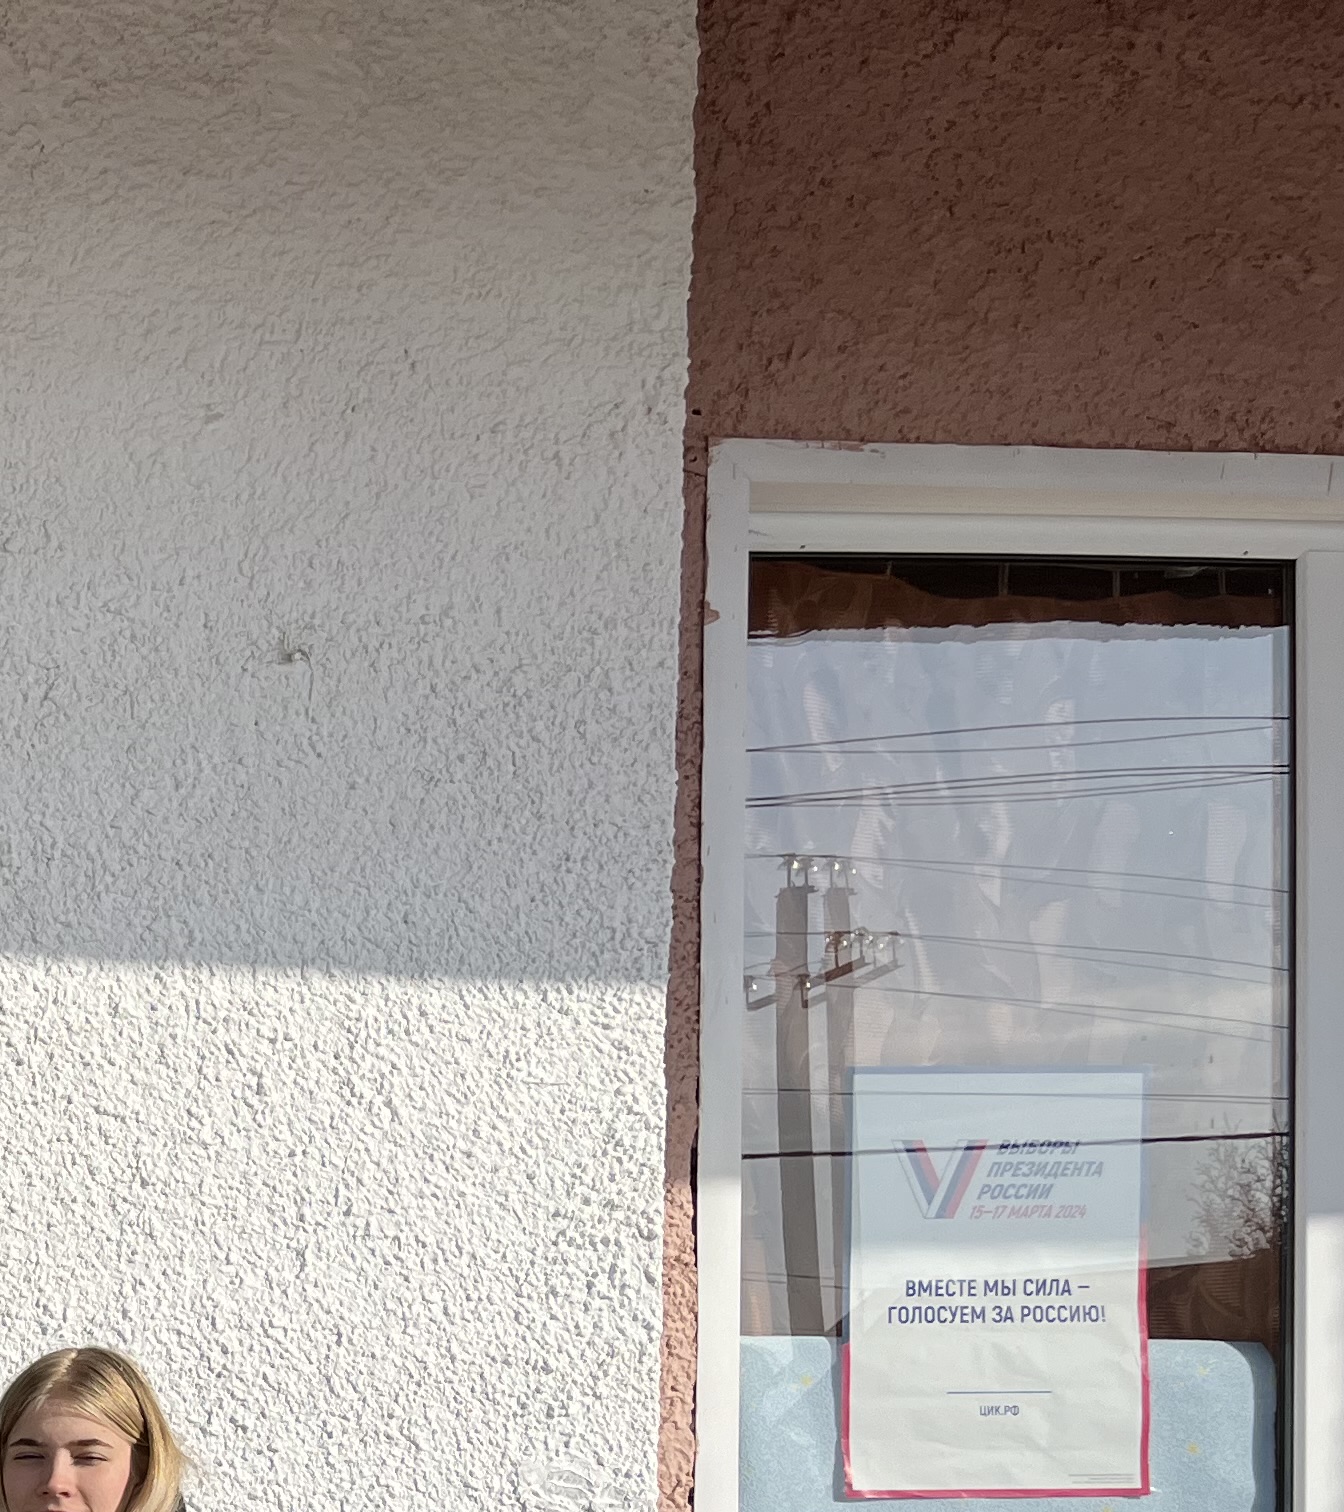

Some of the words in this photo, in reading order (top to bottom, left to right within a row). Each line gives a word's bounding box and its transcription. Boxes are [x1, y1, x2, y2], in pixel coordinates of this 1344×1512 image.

[987, 1161, 1104, 1179] ПРЕЗИДЕНТА
[977, 1183, 1054, 1200] РОССИИ
[1008, 1205, 1053, 1219] МАРТА
[1054, 1204, 1088, 1219] 2024
[905, 1279, 977, 1297] ВМЕСТЕ
[983, 1279, 1016, 1297] МЫ
[1023, 1278, 1072, 1297] СИЛА
[887, 1306, 986, 1324] ГОЛОСУЕМ
[992, 1306, 1015, 1324] ЗА
[1020, 1305, 1107, 1324] РОССИЮ!
[979, 1405, 1020, 1417] ЦИК.РФ
